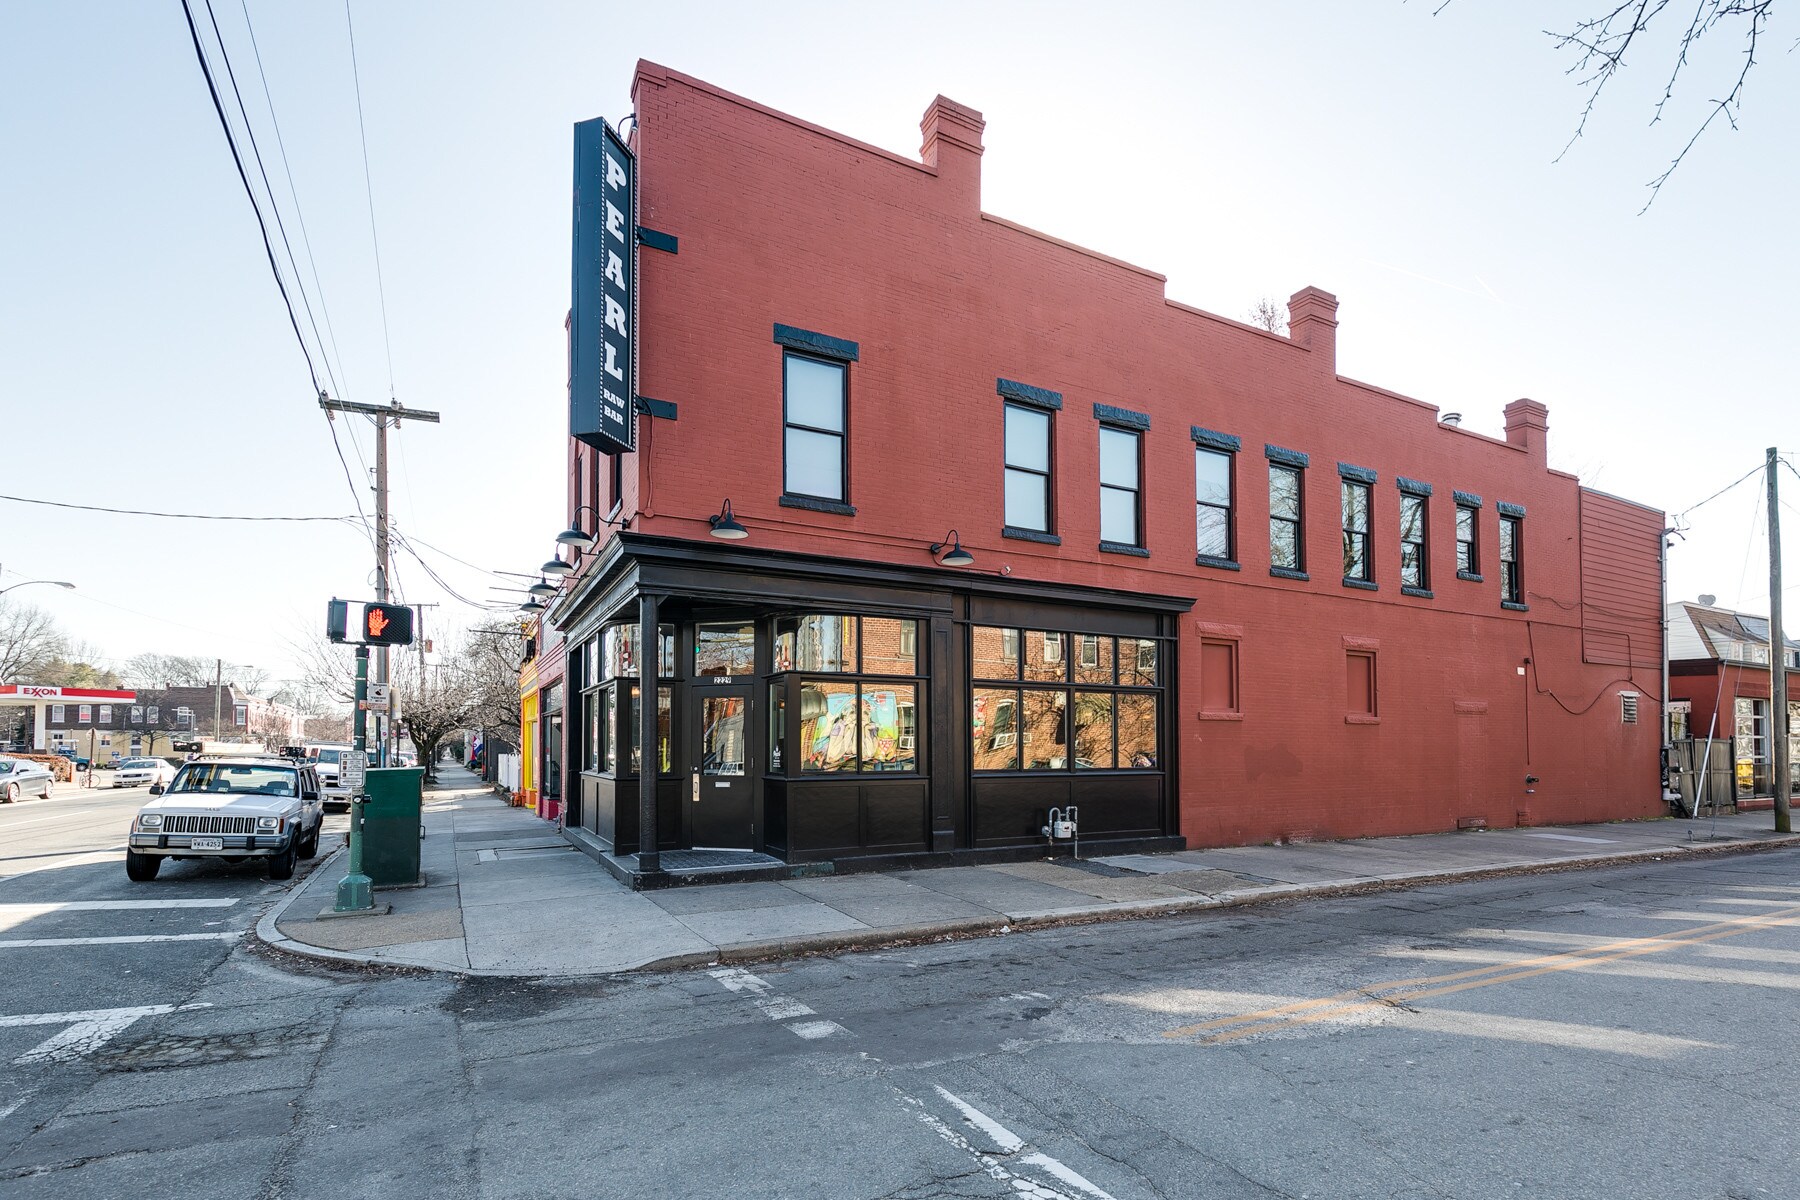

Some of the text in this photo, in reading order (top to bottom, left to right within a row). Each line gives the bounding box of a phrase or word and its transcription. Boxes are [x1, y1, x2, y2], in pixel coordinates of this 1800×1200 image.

[605, 151, 627, 382] PEARL
[603, 388, 625, 409] RAW
[604, 405, 624, 426] BAR
[714, 676, 731, 684] 2229
[23, 687, 57, 698] EXXON
